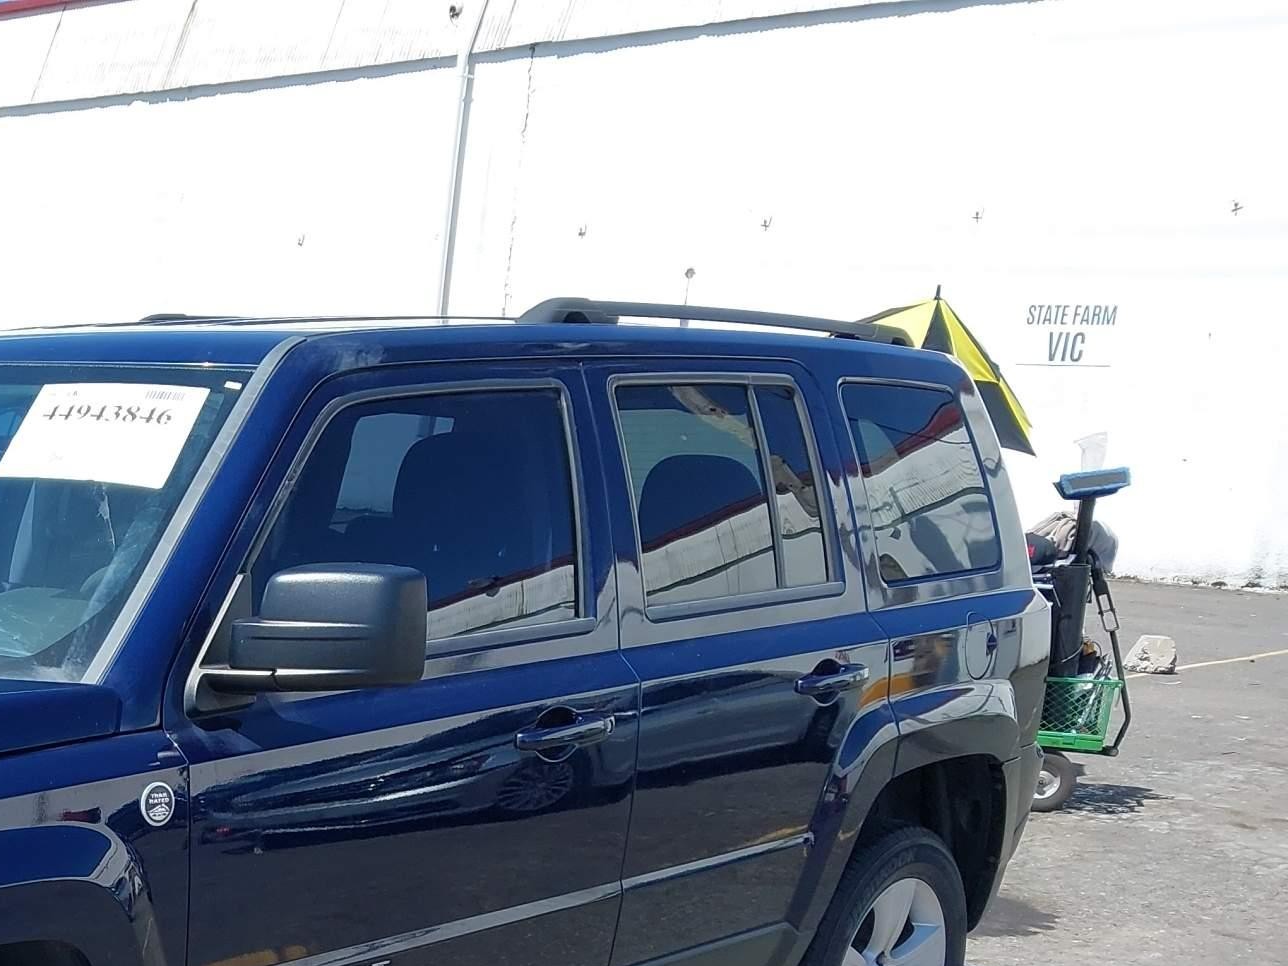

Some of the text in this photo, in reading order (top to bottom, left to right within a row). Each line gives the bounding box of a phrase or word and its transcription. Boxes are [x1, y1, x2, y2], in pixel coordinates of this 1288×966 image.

[1026, 304, 1119, 326] STATE FARM
[1047, 331, 1086, 362] VIC
[42, 404, 174, 425] 44943846
